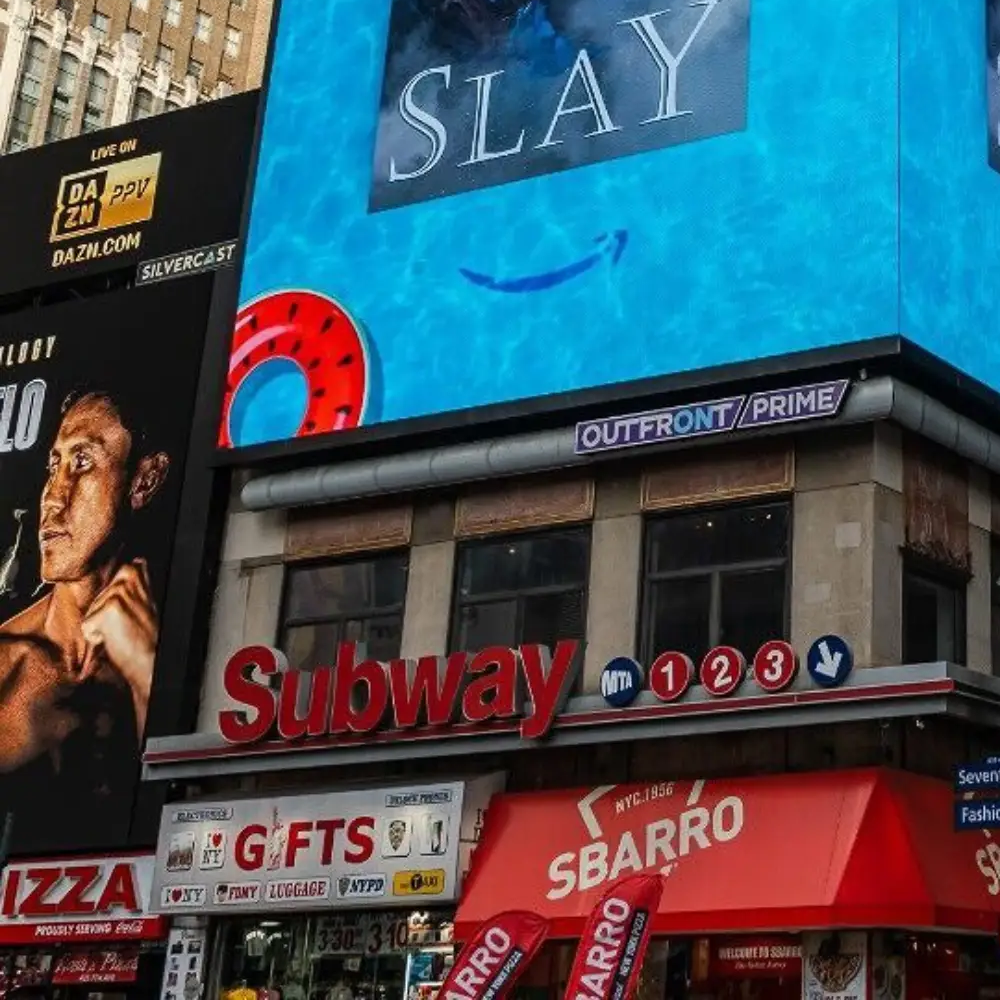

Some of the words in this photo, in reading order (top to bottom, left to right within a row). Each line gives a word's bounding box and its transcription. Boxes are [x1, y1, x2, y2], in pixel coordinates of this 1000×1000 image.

[91, 143, 116, 161] LIVE
[119, 139, 137, 154] ON
[109, 177, 151, 205] PPV
[52, 232, 142, 267] DAZN.COM
[142, 244, 236, 280] SILVERCAST
[0, 378, 47, 453] LO
[582, 403, 734, 448] OUTFRONT
[753, 386, 835, 420] PRIME
[219, 639, 580, 744] Subway
[601, 669, 632, 697] MTA
[660, 660, 674, 691] 1
[710, 654, 733, 687] 2
[763, 651, 786, 681] 3
[546, 795, 744, 900] SBARRO
[1, 862, 141, 917] IZZA
[229, 886, 258, 900] FDNY
[269, 880, 326, 898] LUGGAGE
[350, 879, 384, 894] NYPD
